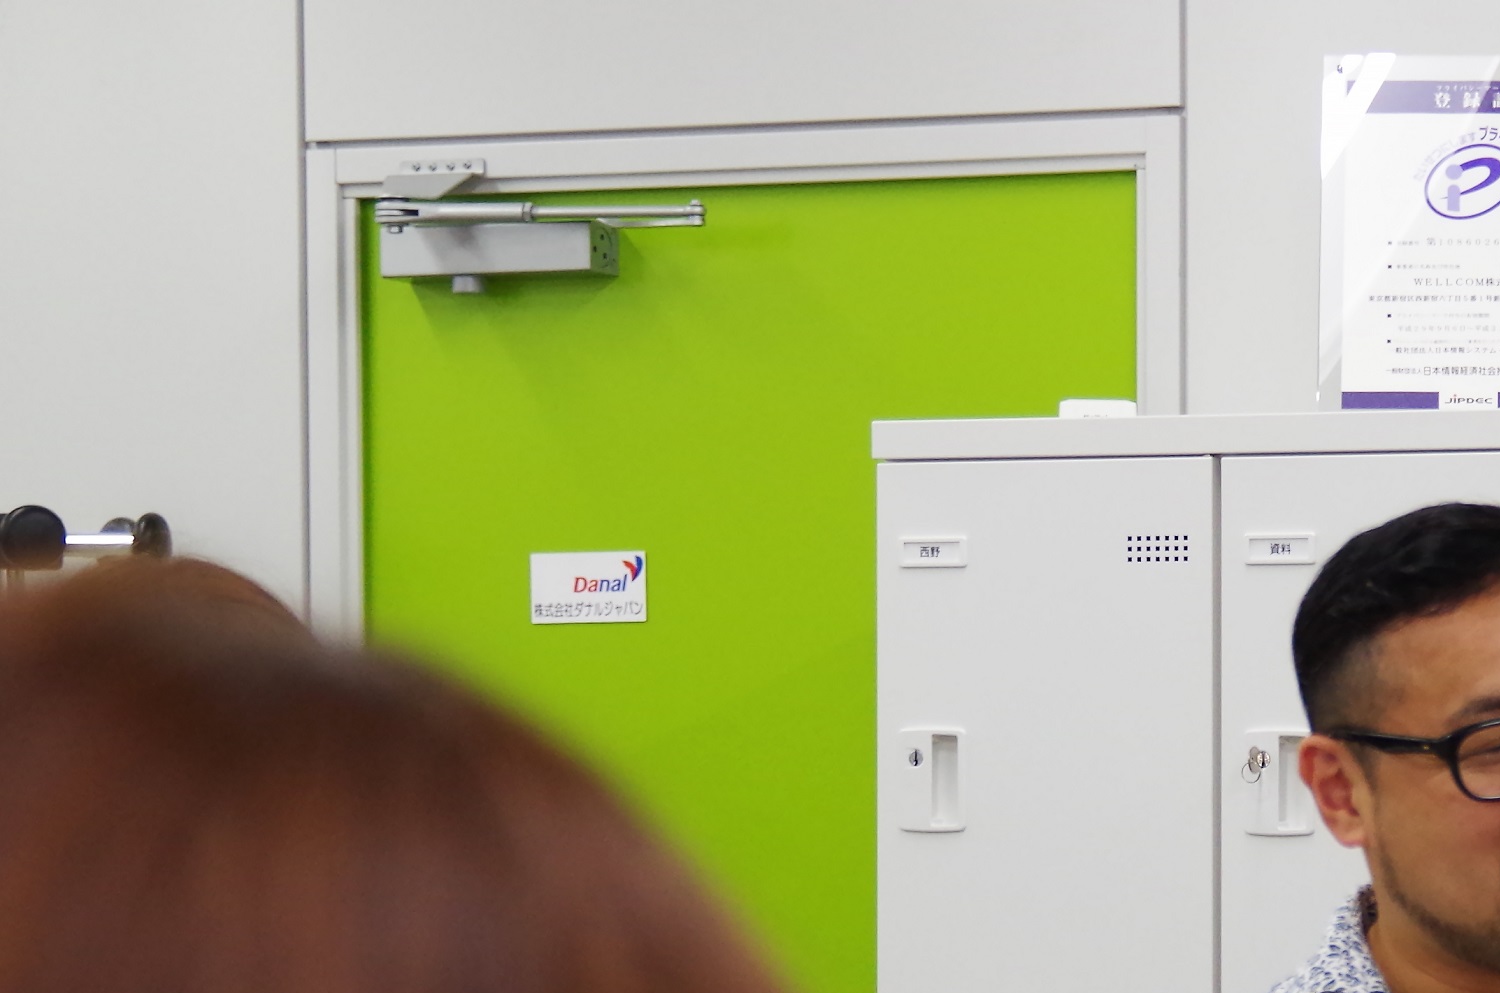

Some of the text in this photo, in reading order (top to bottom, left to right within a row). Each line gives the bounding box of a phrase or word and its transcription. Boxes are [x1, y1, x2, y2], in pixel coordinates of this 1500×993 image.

[573, 573, 628, 593] Danal
[534, 601, 644, 618] 株式会社ダナルジャパン
